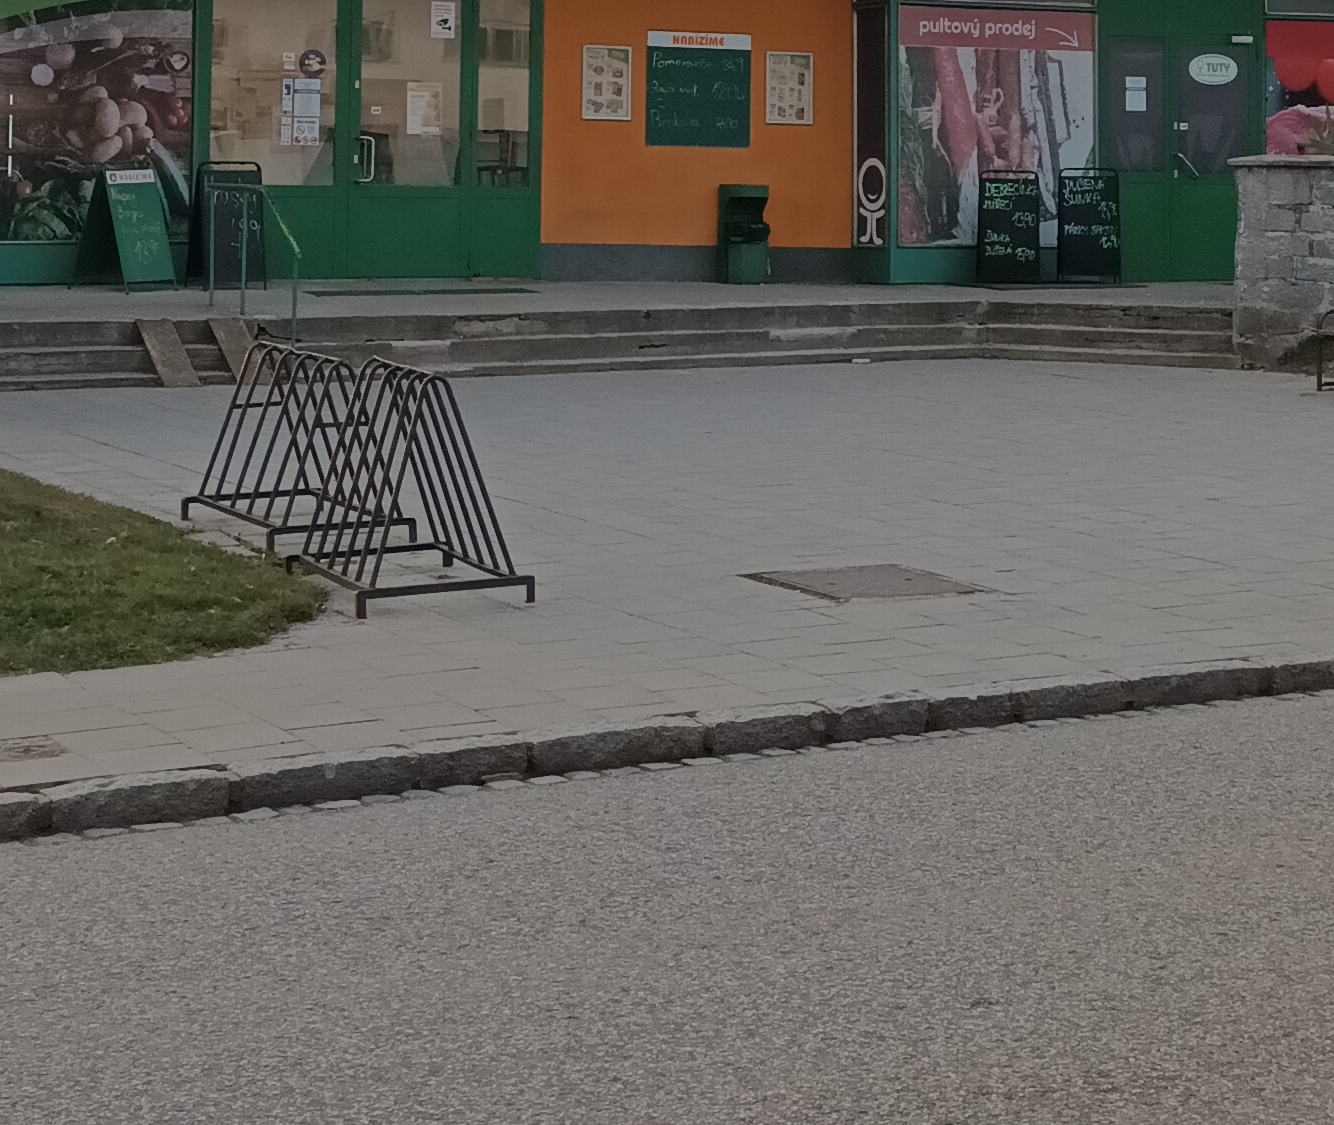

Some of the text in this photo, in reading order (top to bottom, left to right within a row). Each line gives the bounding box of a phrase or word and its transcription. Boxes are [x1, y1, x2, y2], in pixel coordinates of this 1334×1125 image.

[919, 17, 1036, 40] pultový prodej
[672, 34, 725, 47] NABÍZÍME
[1206, 62, 1231, 74] TUTY
